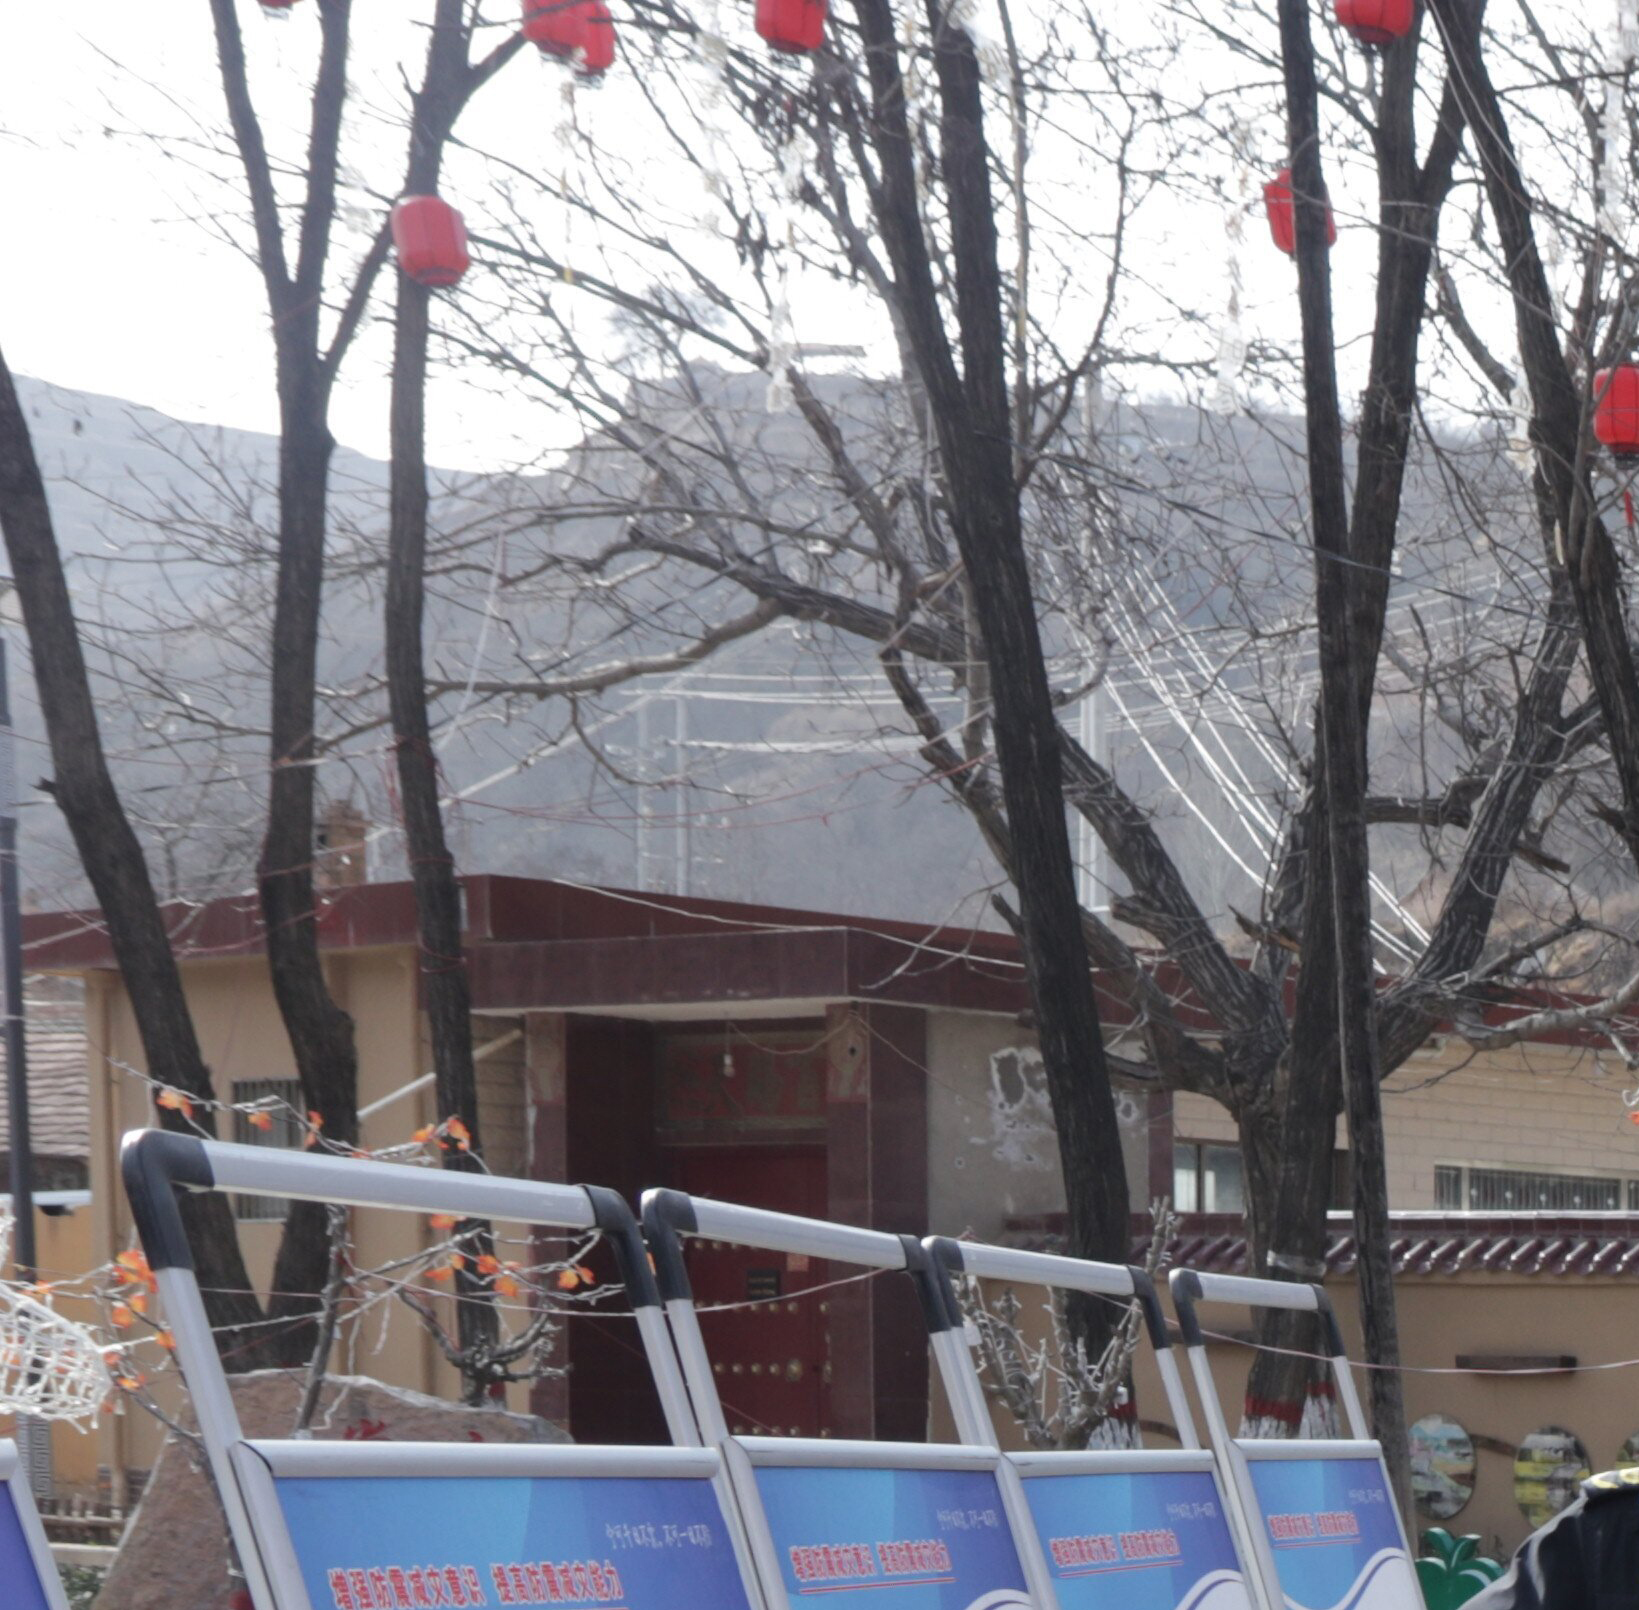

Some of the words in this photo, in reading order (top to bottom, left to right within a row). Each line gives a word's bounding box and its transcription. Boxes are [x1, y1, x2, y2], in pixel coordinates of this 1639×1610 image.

[487, 1557, 625, 1608] 提高防震减灾能力
